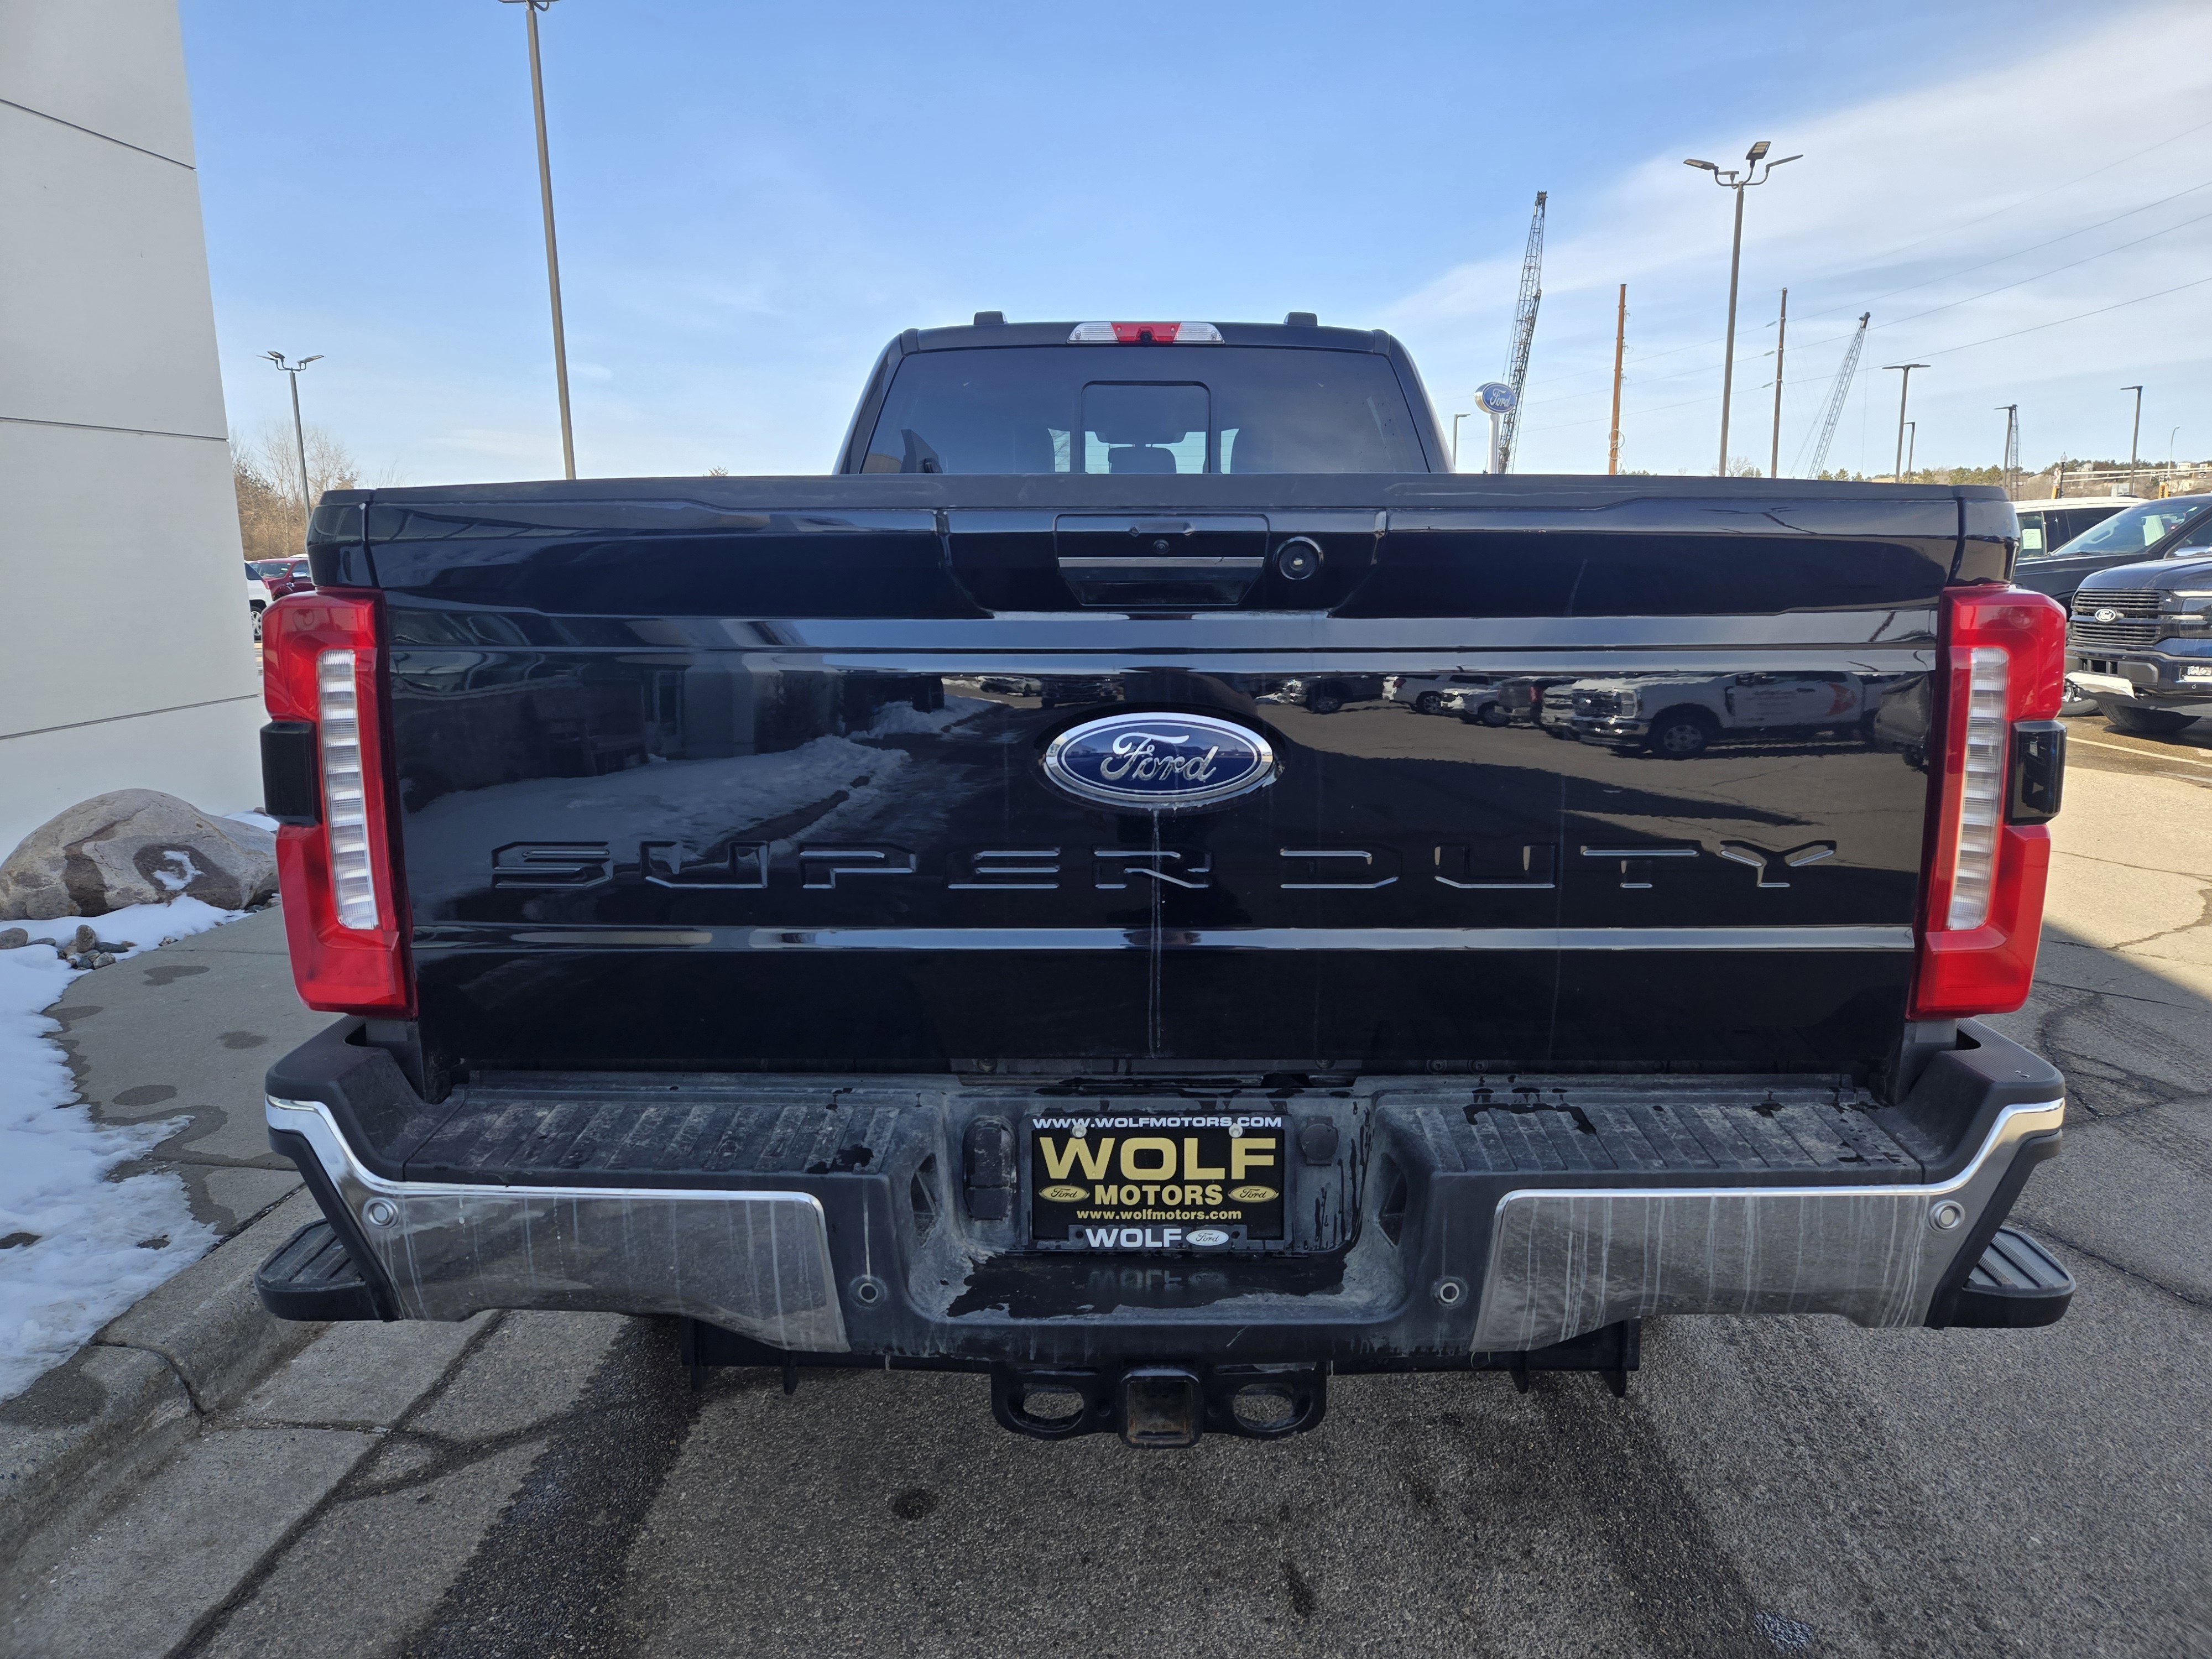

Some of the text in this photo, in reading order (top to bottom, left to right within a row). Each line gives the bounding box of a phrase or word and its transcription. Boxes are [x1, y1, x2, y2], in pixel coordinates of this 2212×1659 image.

[1489, 388, 1511, 407] Ford
[1100, 732, 1219, 782] Ford
[490, 839, 1837, 888] SUPER DUTY
[1039, 1137, 1276, 1180] WOLF
[1051, 1188, 1078, 1198] Ford
[1094, 1185, 1223, 1206] MOTORS
[1240, 1188, 1267, 1199] Ford
[1077, 1209, 1242, 1220] www.wolfmotors.com
[1086, 1228, 1219, 1248] WOLF Ford
